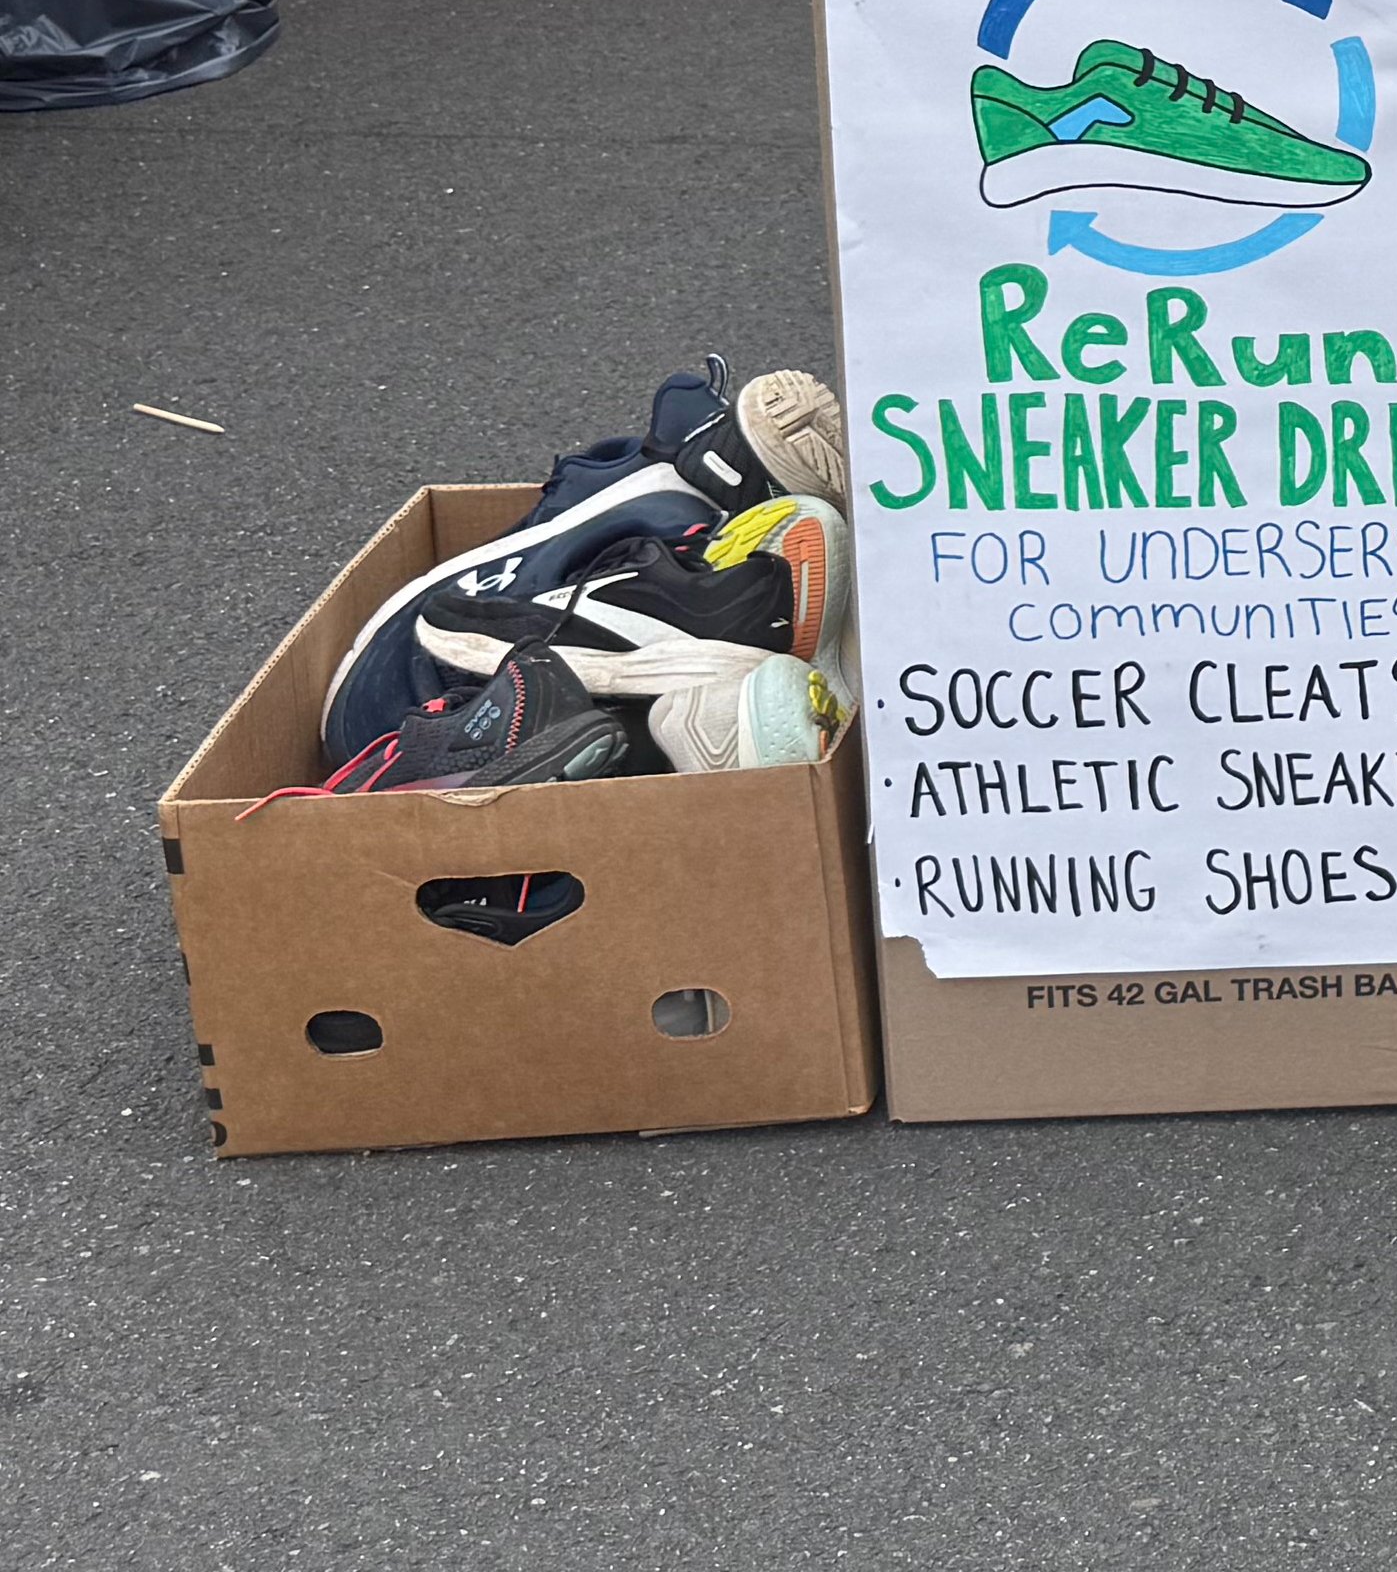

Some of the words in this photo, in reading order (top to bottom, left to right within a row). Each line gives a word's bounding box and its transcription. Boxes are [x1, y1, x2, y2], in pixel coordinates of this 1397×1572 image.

[980, 262, 1397, 387] ReRun
[869, 391, 1251, 512] SNEAKER
[930, 529, 1051, 587] FOR
[899, 660, 1152, 737] SOCCER
[909, 754, 1181, 819] ATHLETIC
[915, 849, 1157, 919] RUNNING
[1027, 984, 1099, 1010] FITS
[1107, 980, 1146, 1008] 42
[1154, 978, 1222, 1006] GAL
[1230, 974, 1344, 1004] TRASH
